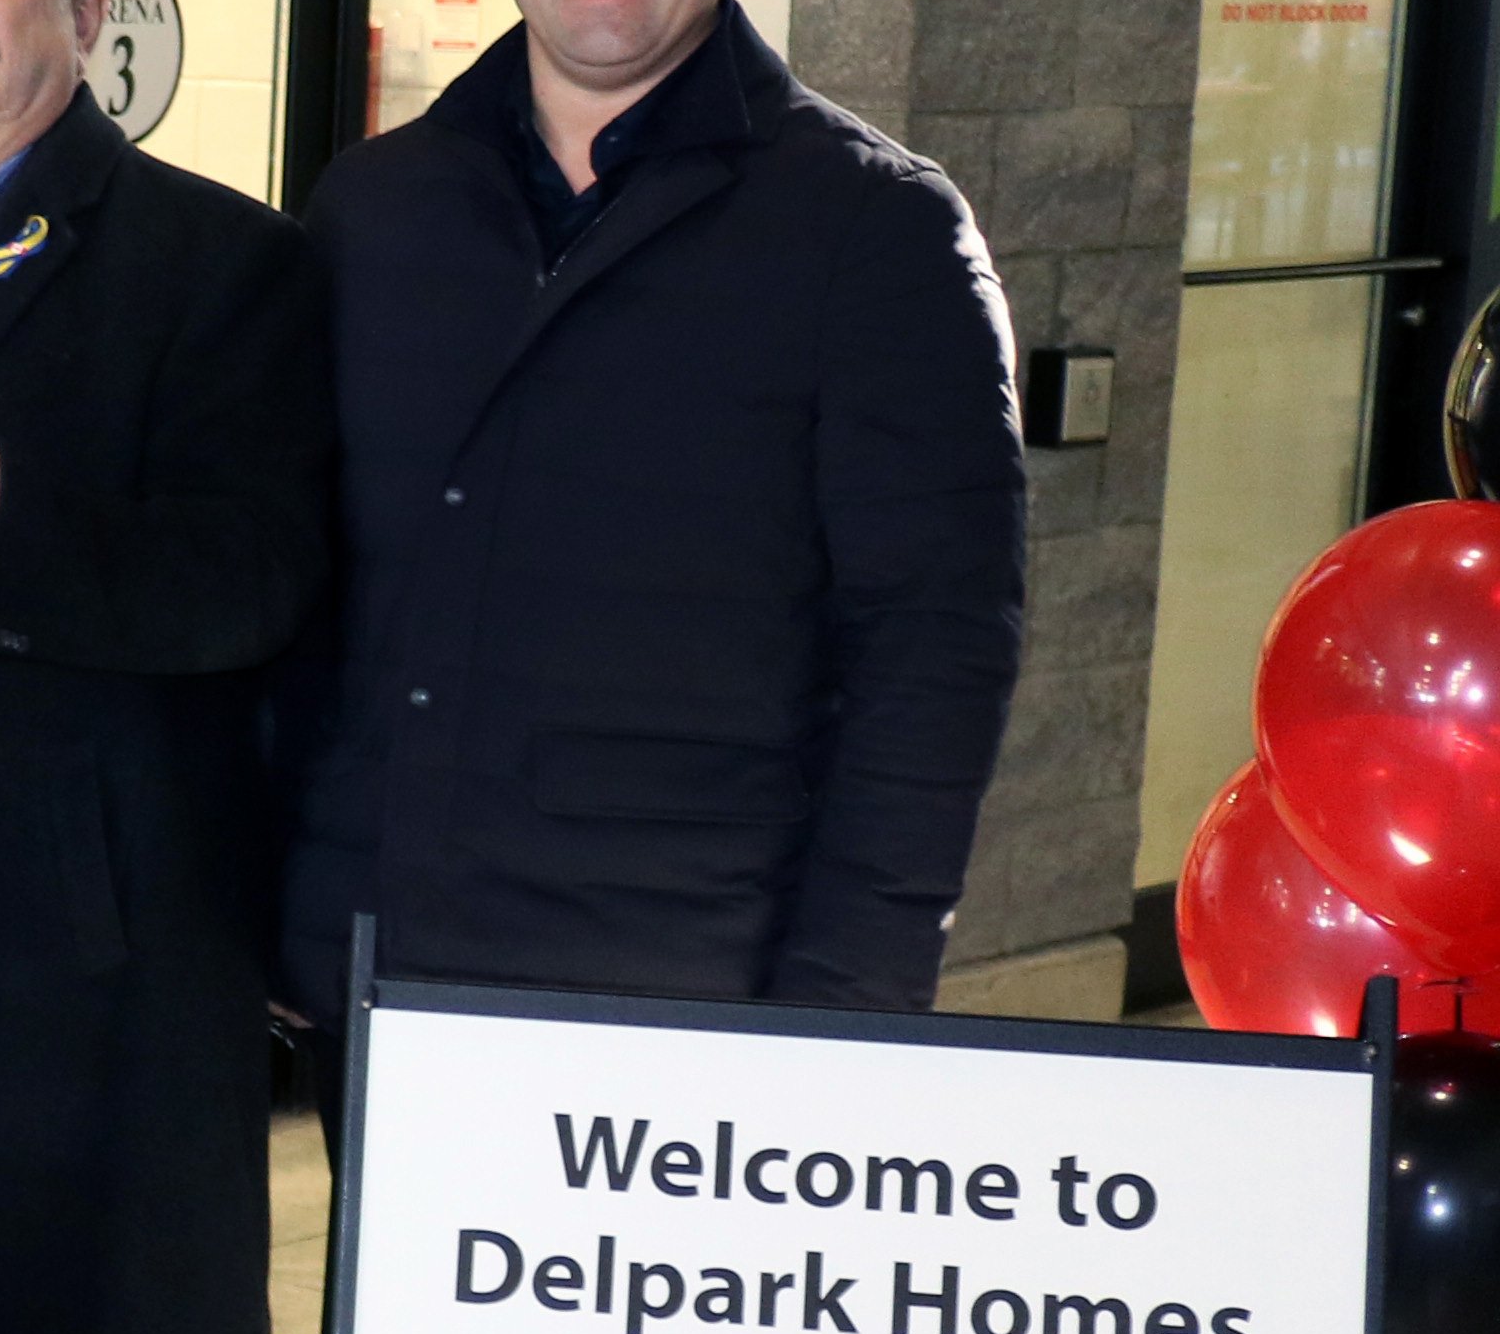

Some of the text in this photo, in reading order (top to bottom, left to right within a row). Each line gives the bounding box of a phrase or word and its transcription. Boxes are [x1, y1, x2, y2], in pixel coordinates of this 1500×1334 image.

[108, 34, 136, 118] 3
[554, 1114, 1156, 1230] Welcome to
